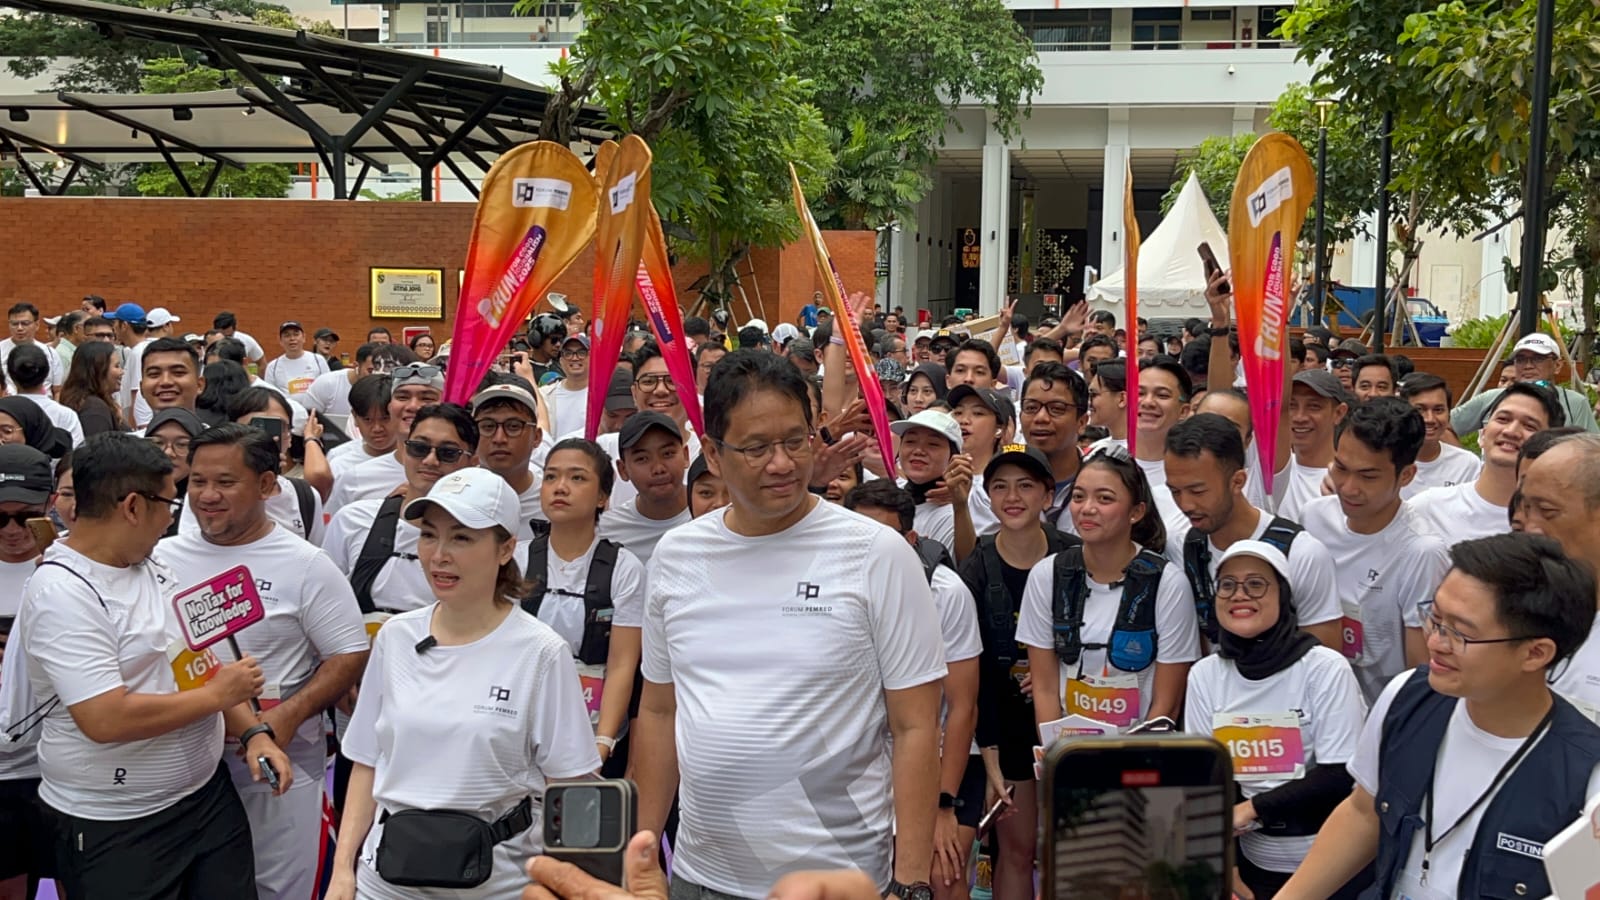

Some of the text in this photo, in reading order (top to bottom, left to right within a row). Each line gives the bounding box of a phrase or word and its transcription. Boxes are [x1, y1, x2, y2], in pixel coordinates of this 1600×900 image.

[510, 256, 521, 272] FOR
[519, 256, 535, 282] 2025
[492, 269, 520, 314] RUN
[1265, 273, 1275, 292] FOR
[642, 287, 658, 313] 2025
[1262, 291, 1283, 342] RUN
[185, 582, 244, 619] No Tax for
[190, 598, 252, 638] Knowledge
[1073, 690, 1128, 714] 16149
[1226, 738, 1285, 758] 16115
[1500, 838, 1544, 856] POSTIN
